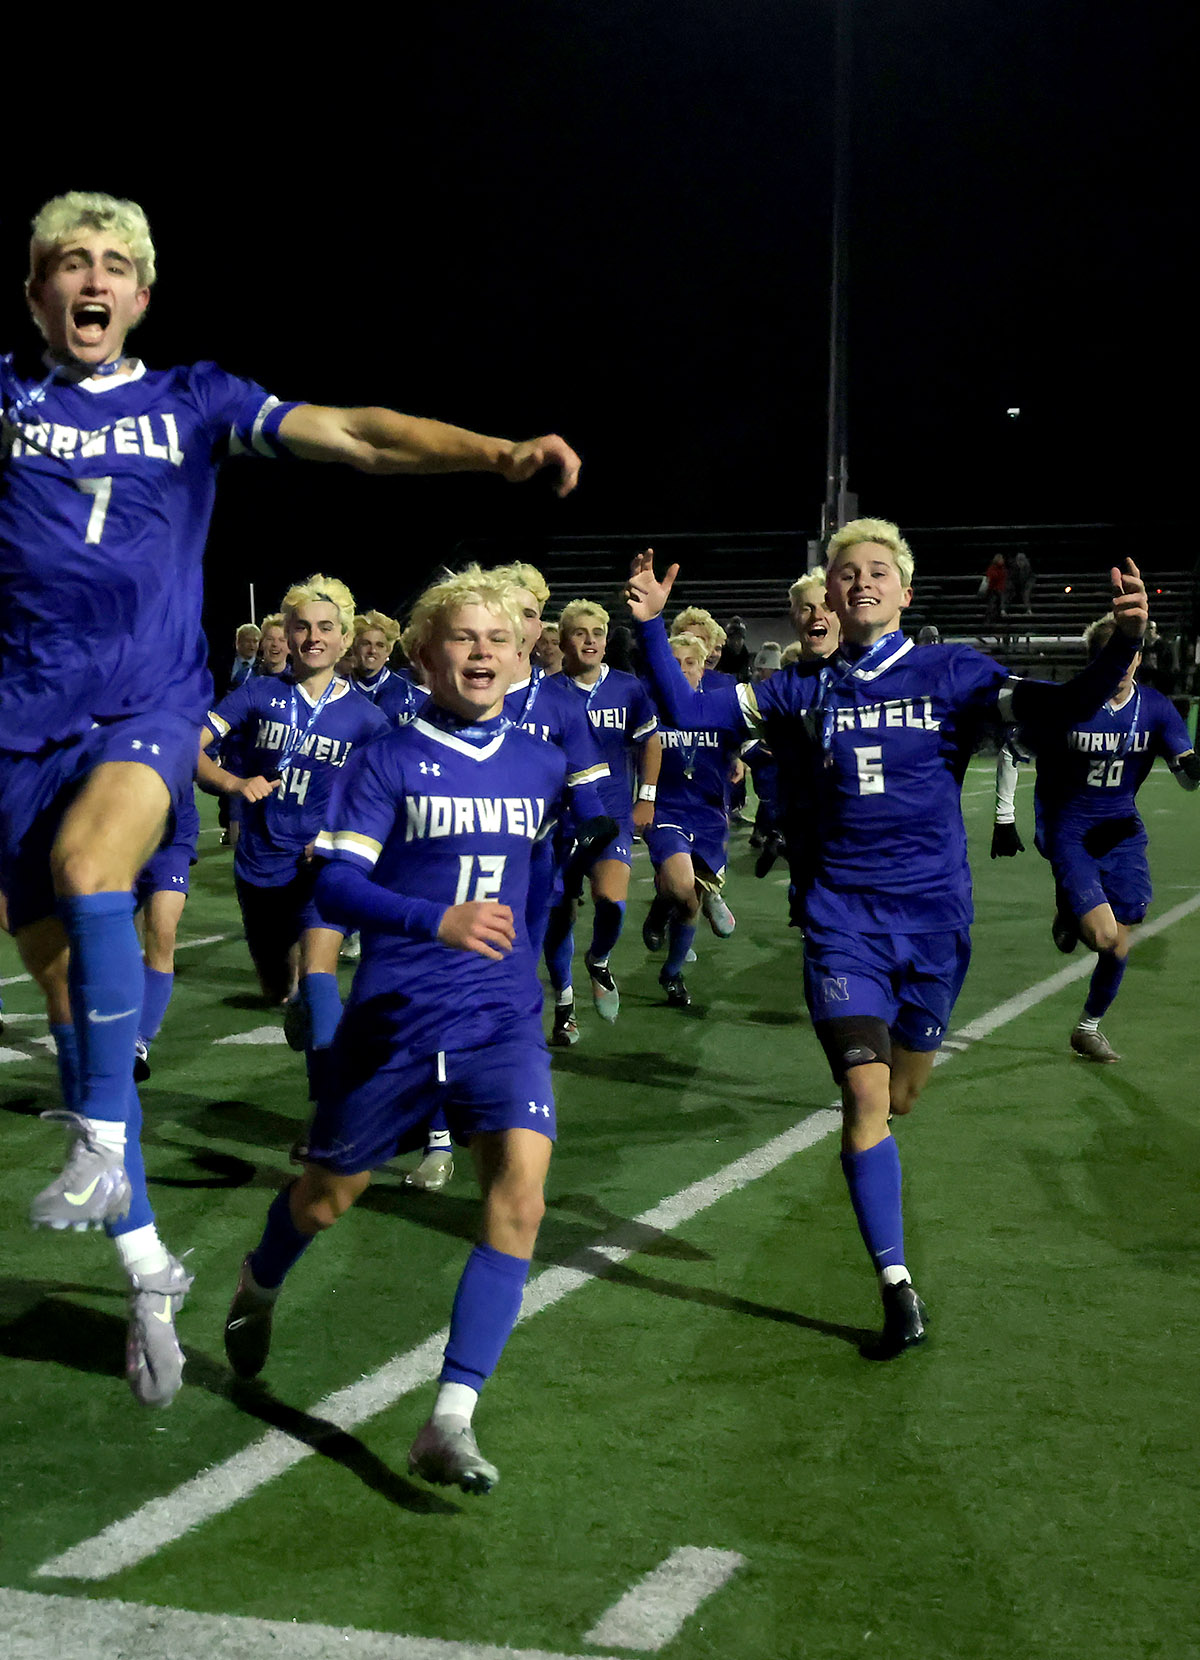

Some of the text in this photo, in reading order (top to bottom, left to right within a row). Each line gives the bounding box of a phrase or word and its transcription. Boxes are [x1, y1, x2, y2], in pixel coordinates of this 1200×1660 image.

[74, 475, 113, 544] 7
[800, 695, 942, 732] RWELL
[1067, 731, 1150, 752] NORWLL
[277, 766, 312, 805] 14
[853, 745, 886, 796] 6
[1087, 759, 1125, 787] 20
[405, 795, 545, 842] NORWELL
[454, 855, 508, 906] 12
